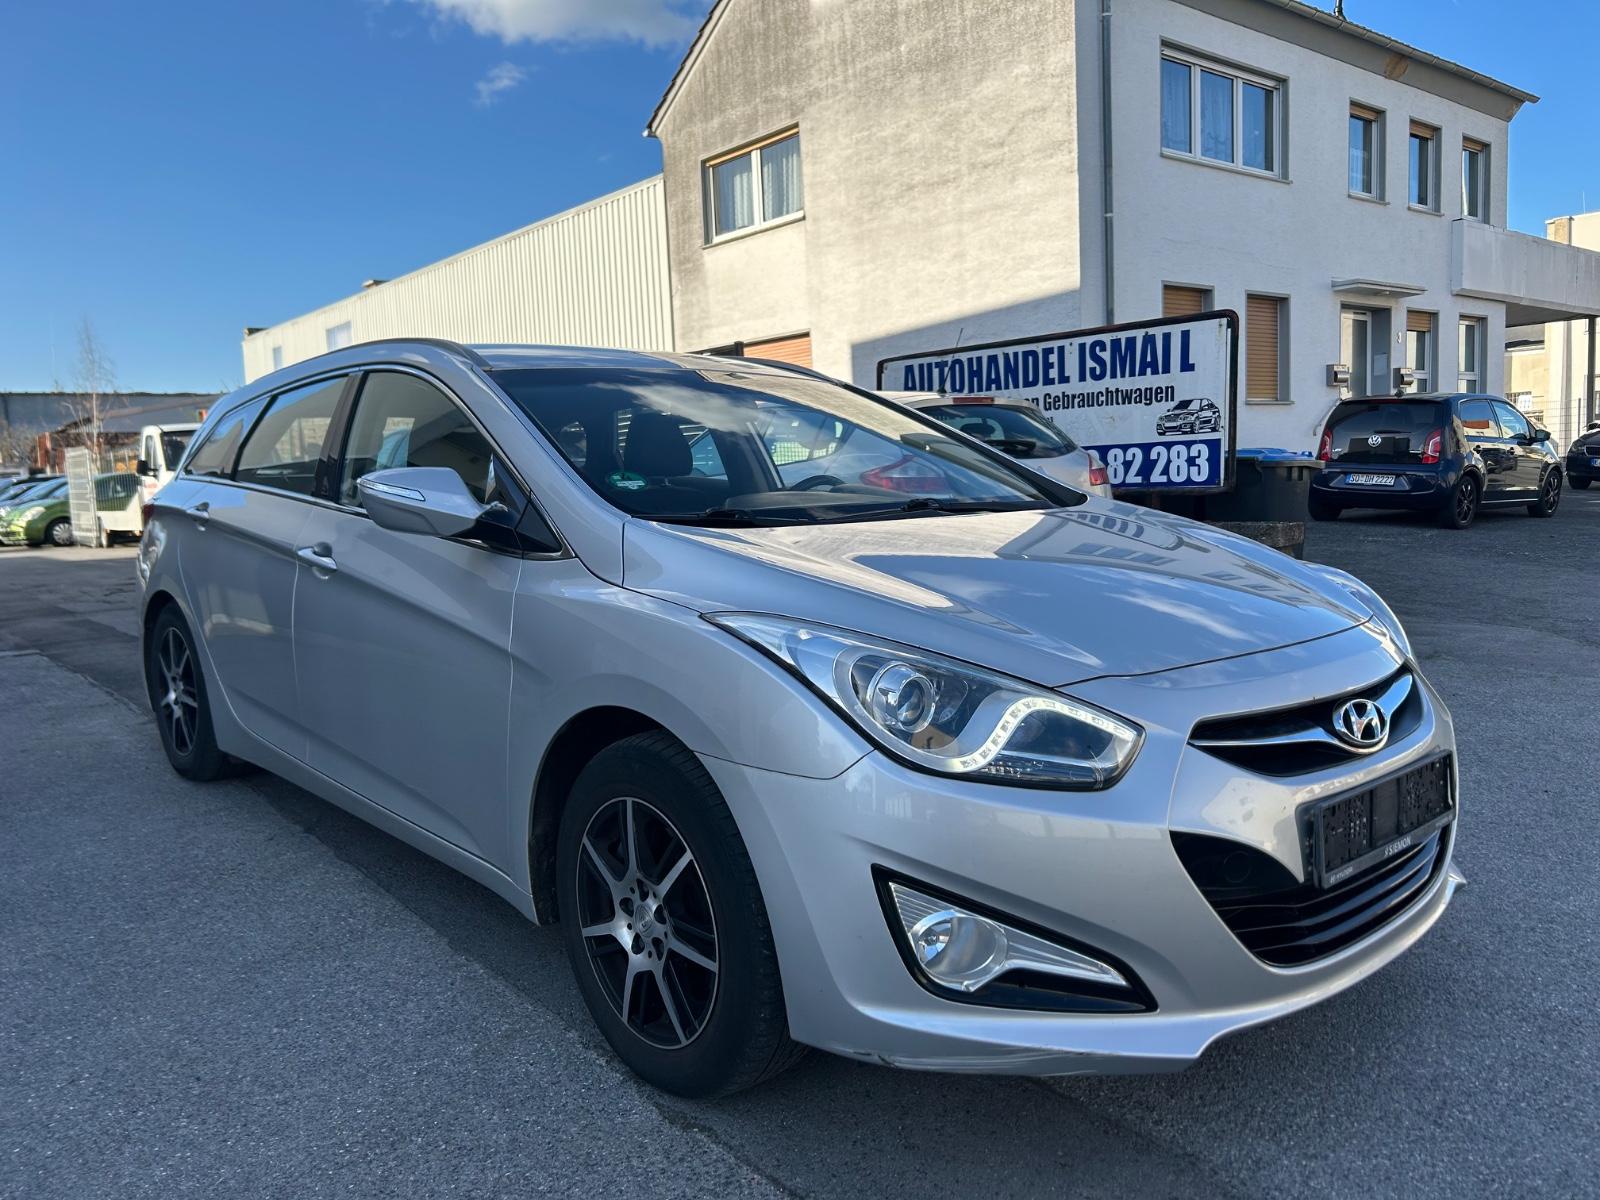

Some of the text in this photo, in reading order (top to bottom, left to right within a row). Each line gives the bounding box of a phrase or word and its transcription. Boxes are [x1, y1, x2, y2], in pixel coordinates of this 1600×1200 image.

[903, 345, 1070, 394] AUTOHANDEL
[1043, 385, 1175, 412] Gebrauchtwagen
[1107, 443, 1209, 485] 82 283
